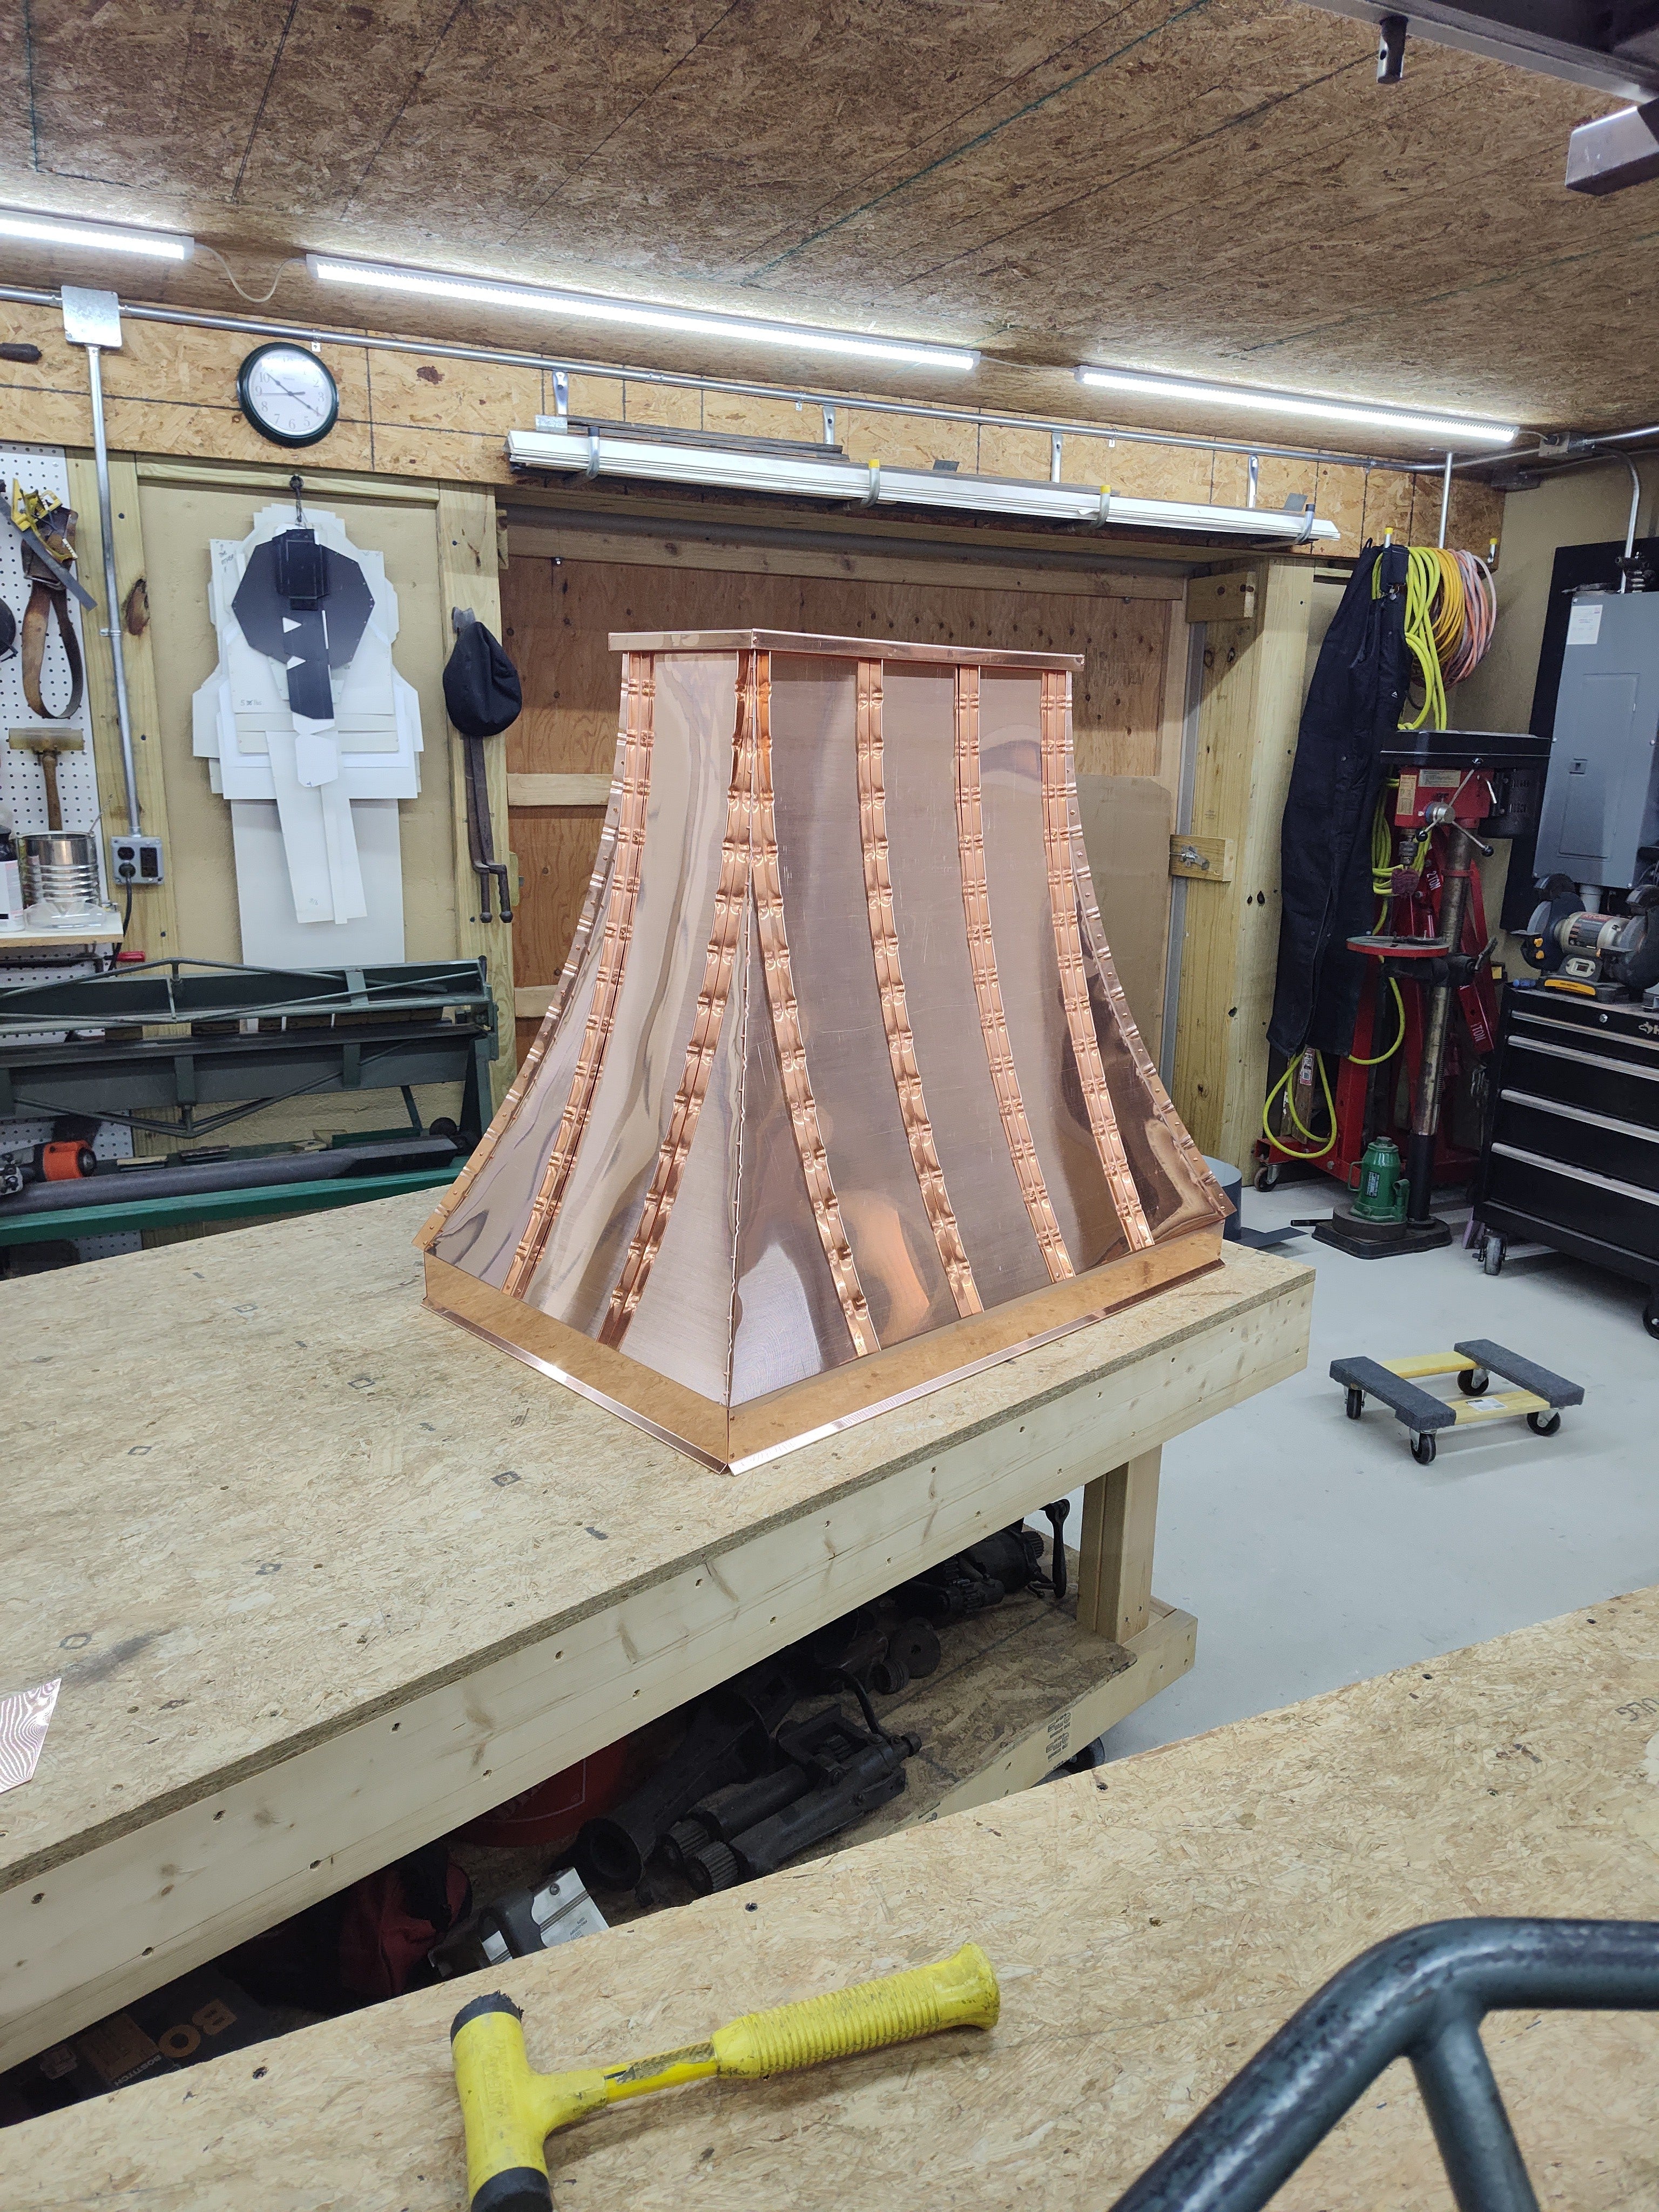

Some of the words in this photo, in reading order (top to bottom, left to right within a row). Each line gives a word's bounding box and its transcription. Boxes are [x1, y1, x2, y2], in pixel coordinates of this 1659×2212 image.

[260, 372, 270, 383] 10
[313, 379, 320, 388] 2
[255, 386, 262, 396] 9
[318, 392, 324, 402] 3
[261, 401, 268, 412] 8
[274, 414, 280, 424] 7
[288, 419, 295, 429] 6
[304, 415, 311, 427] 5
